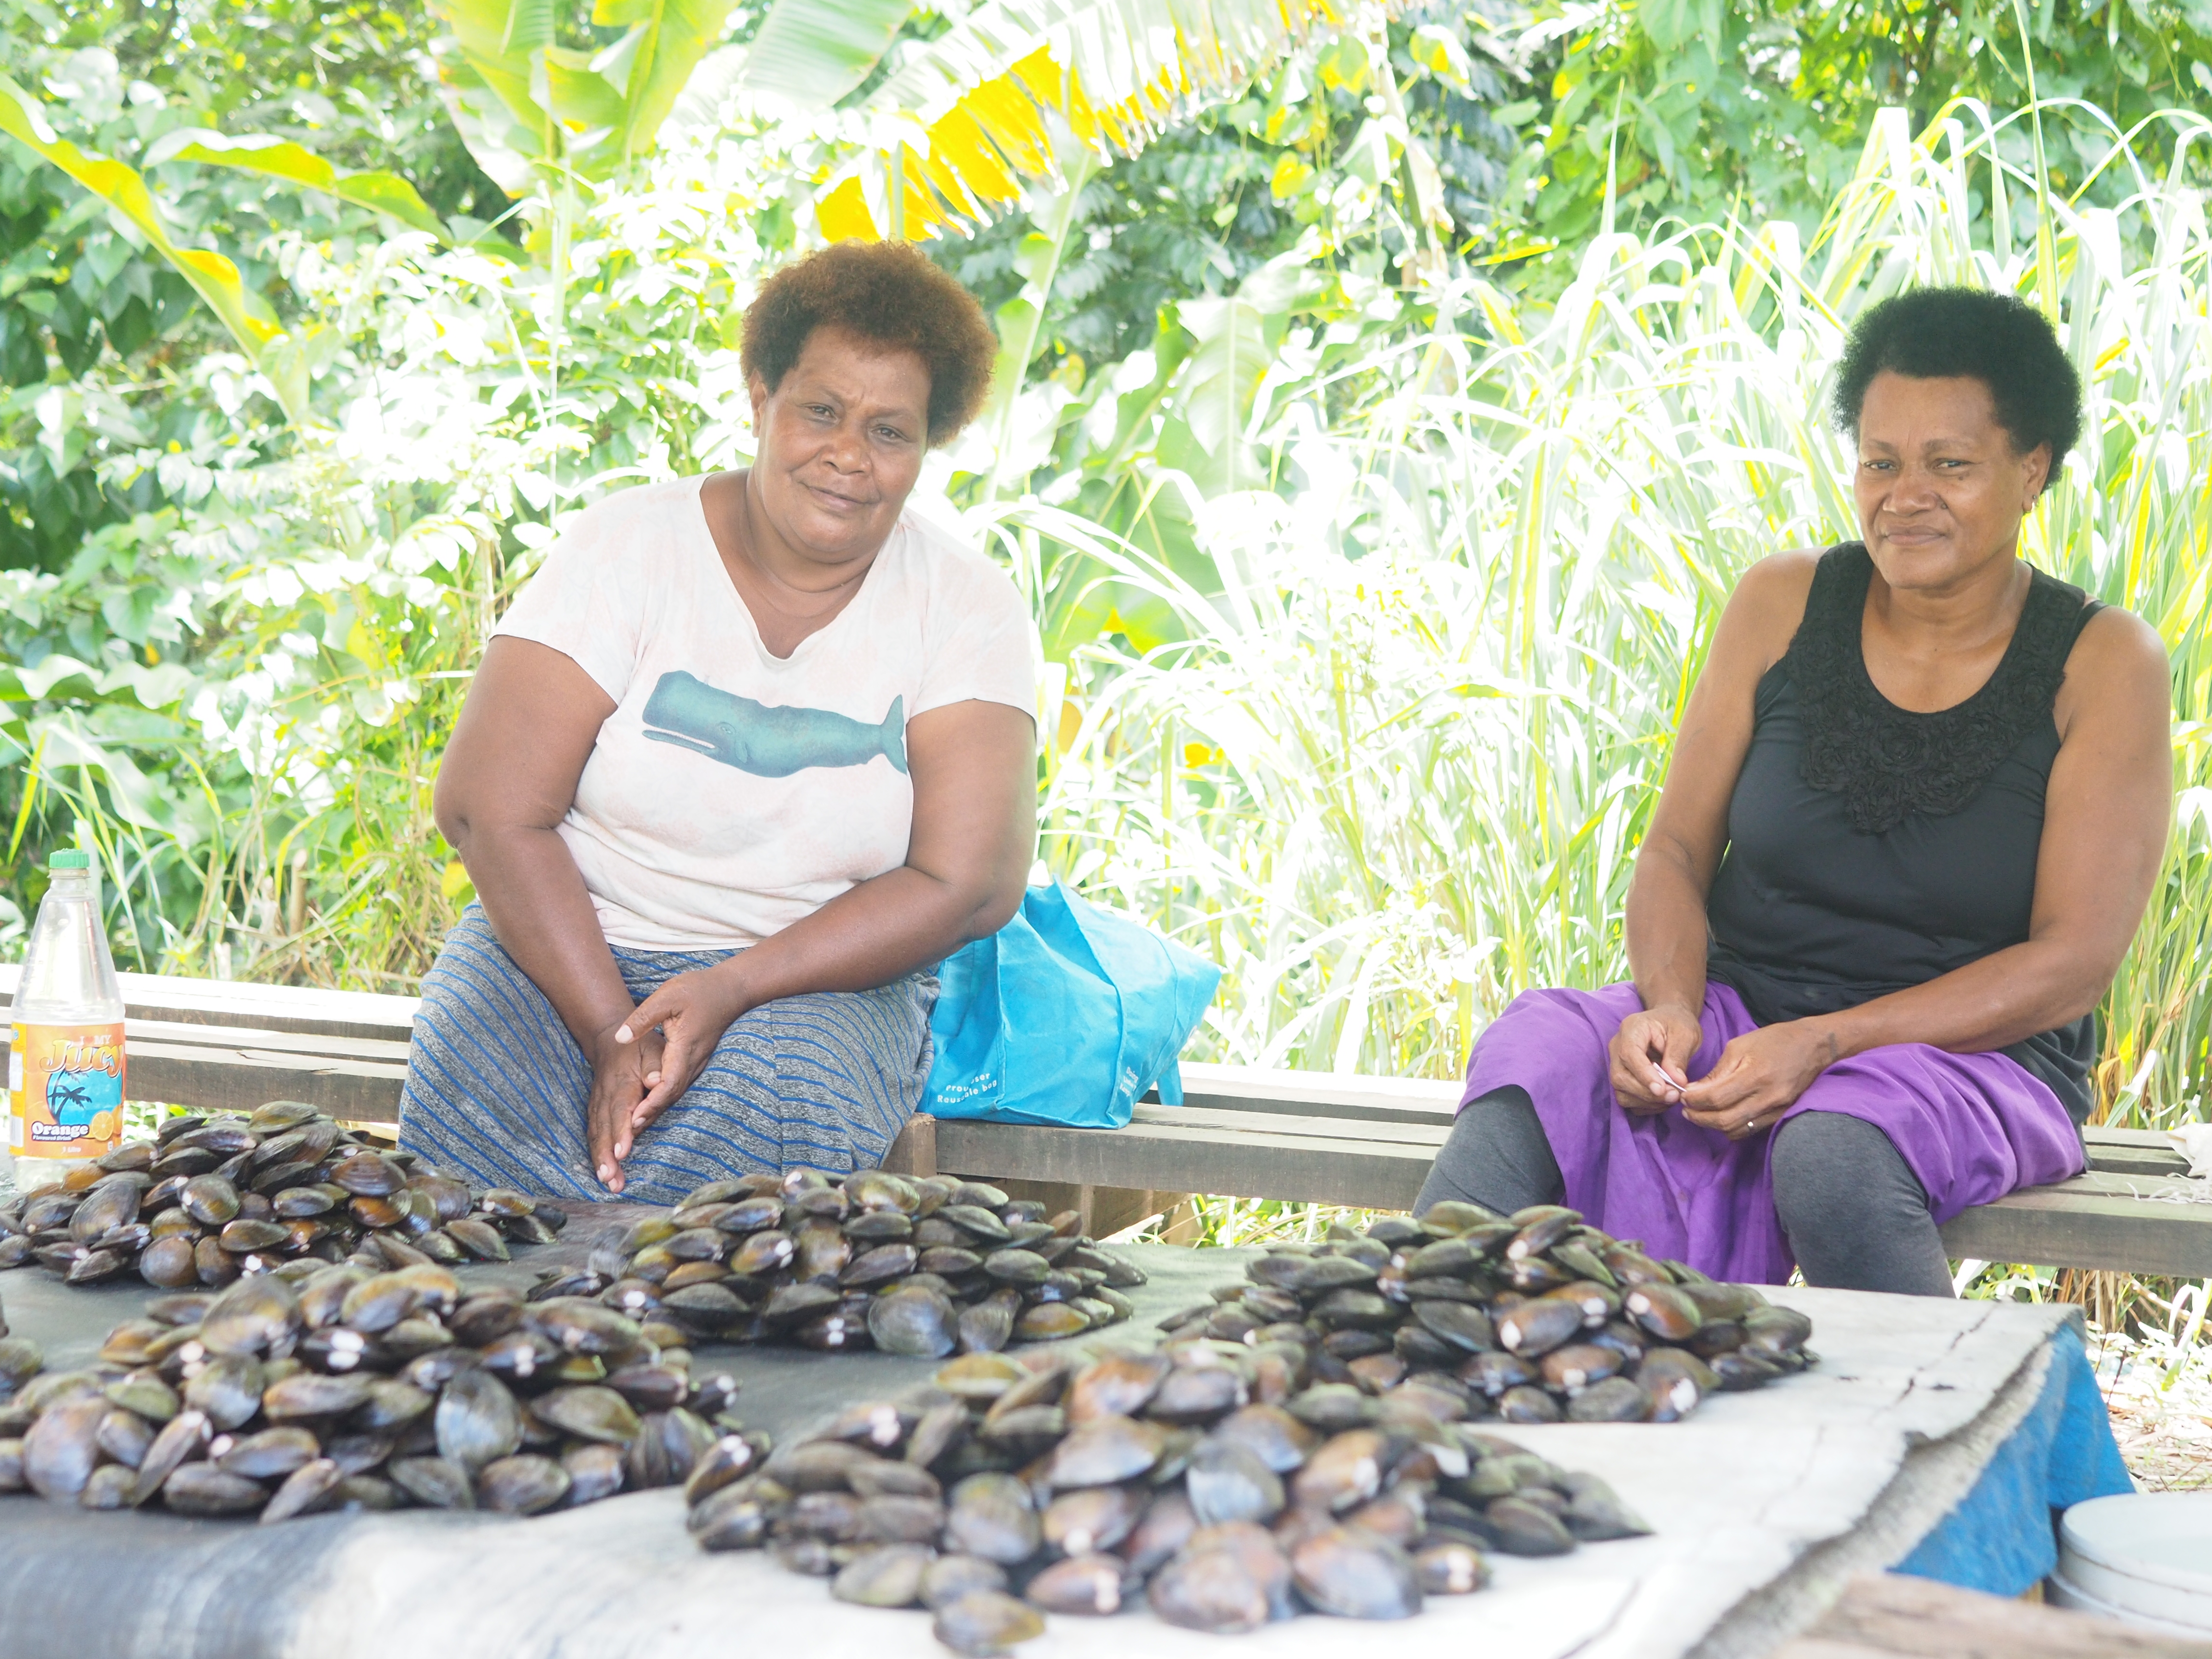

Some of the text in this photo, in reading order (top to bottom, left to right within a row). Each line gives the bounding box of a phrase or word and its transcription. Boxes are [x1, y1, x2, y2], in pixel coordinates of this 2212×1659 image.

[94, 1034, 112, 1045] MY
[39, 1039, 123, 1078] Jucy
[982, 1080, 997, 1092] bag
[32, 1121, 88, 1138] Orange
